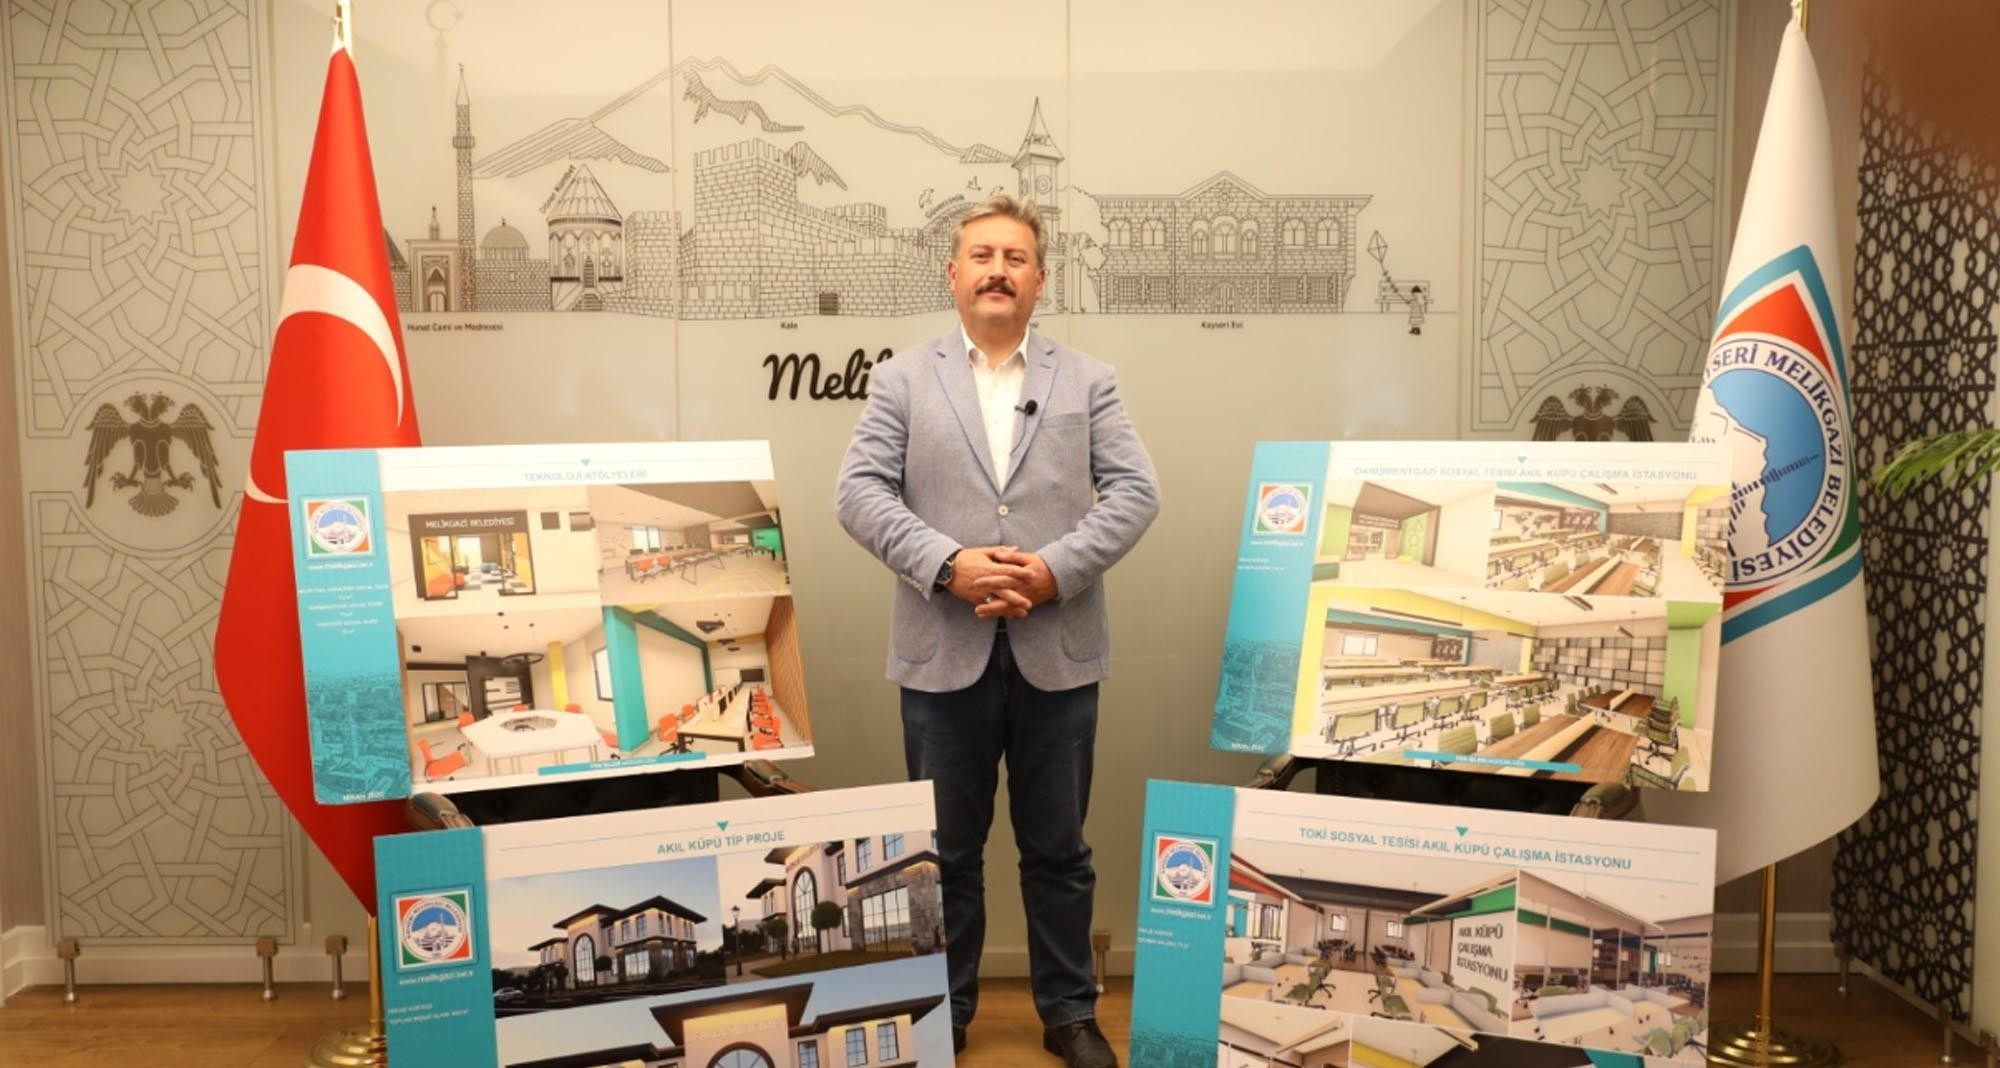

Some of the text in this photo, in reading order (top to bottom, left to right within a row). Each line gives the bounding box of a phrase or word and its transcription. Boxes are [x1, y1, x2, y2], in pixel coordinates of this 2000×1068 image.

[763, 348, 893, 401] Meli
[1764, 350, 1845, 467] MELİKGAZİ
[1632, 467, 1698, 481] İSTASYONU
[1731, 473, 1843, 583] BELEDİYESİ
[657, 831, 785, 855] AKIL KÜPÜ TİP PROJE
[1299, 826, 1632, 870] TOKİ SOSYAL TESİSİ AKIL KÜPÜ ÇALIŞMA İSTASYONU
[1475, 923, 1504, 939] KÜPÜ
